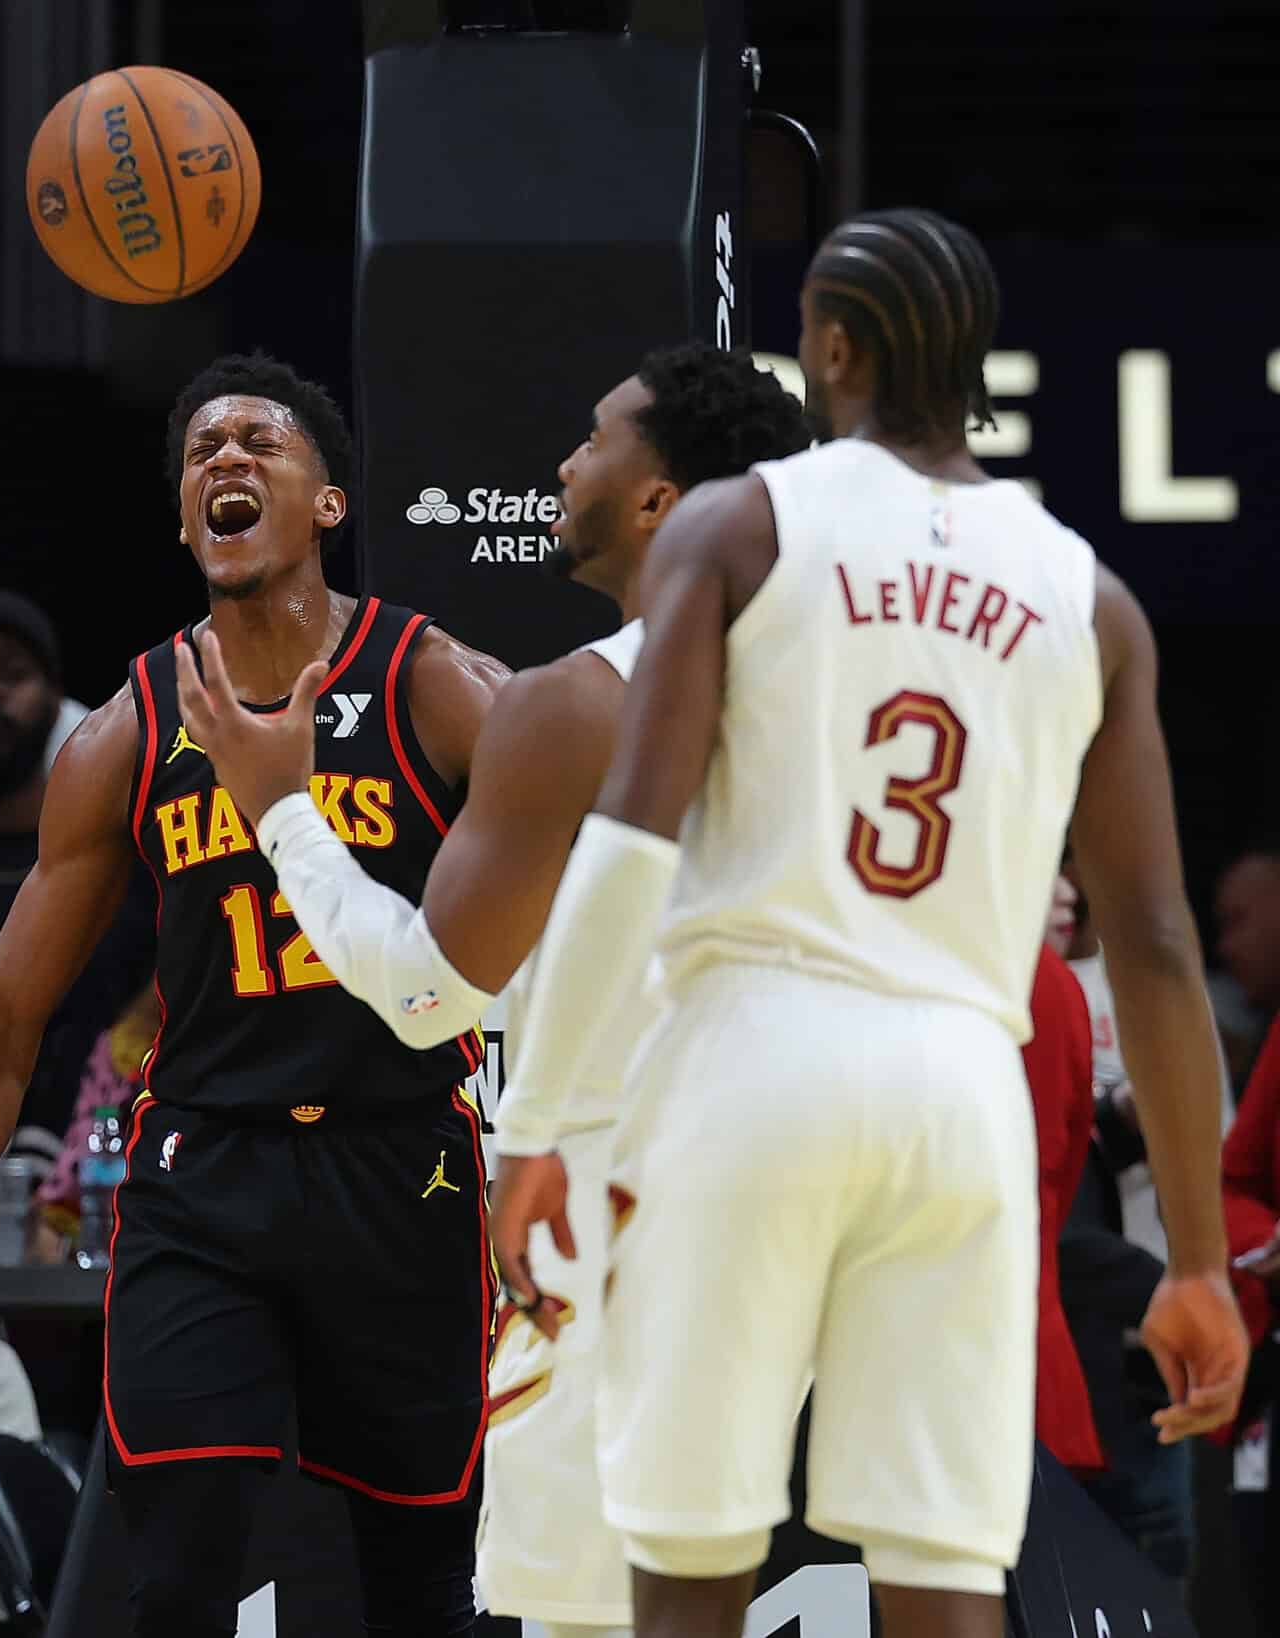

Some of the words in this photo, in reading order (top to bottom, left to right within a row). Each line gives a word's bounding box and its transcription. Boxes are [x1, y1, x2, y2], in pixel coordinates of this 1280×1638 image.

[103, 104, 162, 260] Wilson
[464, 487, 558, 524] State
[470, 535, 560, 563] AREN
[836, 561, 1045, 661] LeVERT
[315, 714, 334, 724] the
[154, 772, 398, 877] HAKS
[847, 690, 968, 900] 3
[220, 883, 339, 997] 12
